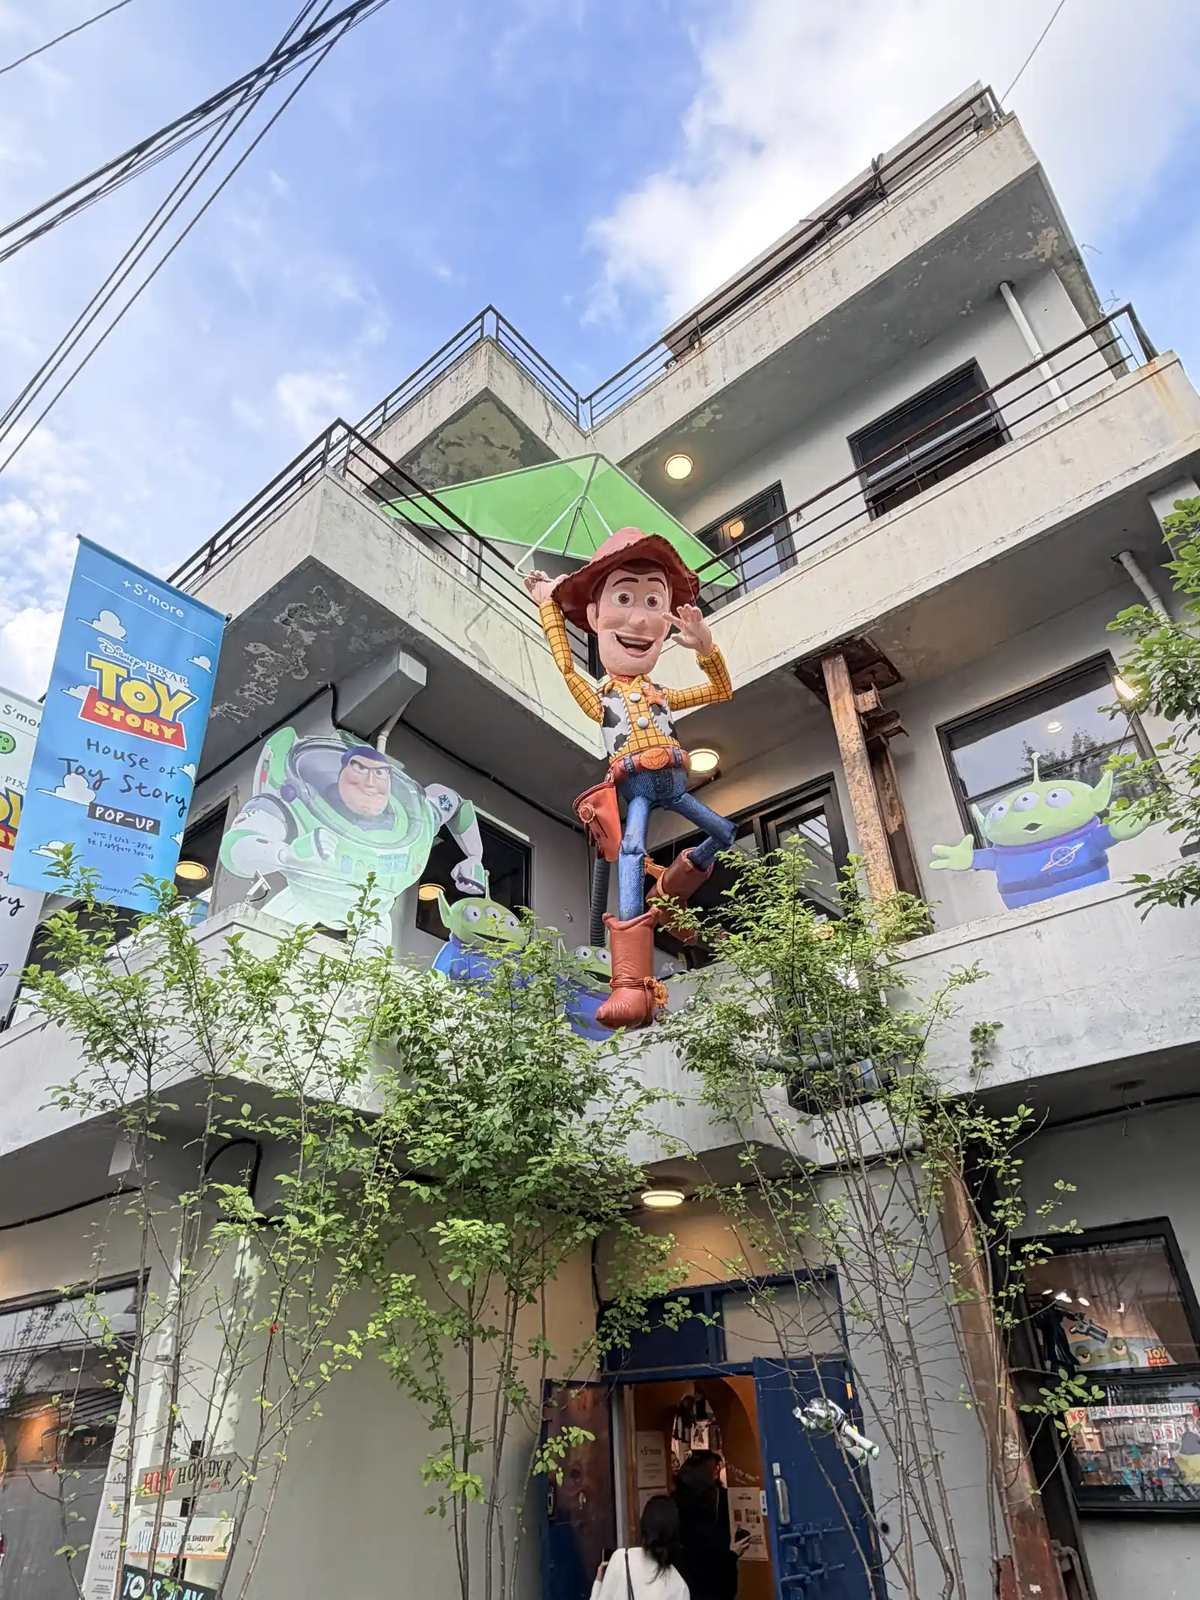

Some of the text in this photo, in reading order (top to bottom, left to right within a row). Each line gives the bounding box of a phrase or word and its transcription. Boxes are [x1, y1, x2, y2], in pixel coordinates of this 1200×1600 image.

[97, 637, 189, 687] Disney PIXAR
[89, 655, 194, 722] TOY
[93, 700, 177, 739] STORY
[86, 738, 177, 778] House of
[57, 757, 188, 818] Toy Story
[95, 806, 155, 831] POP-UP
